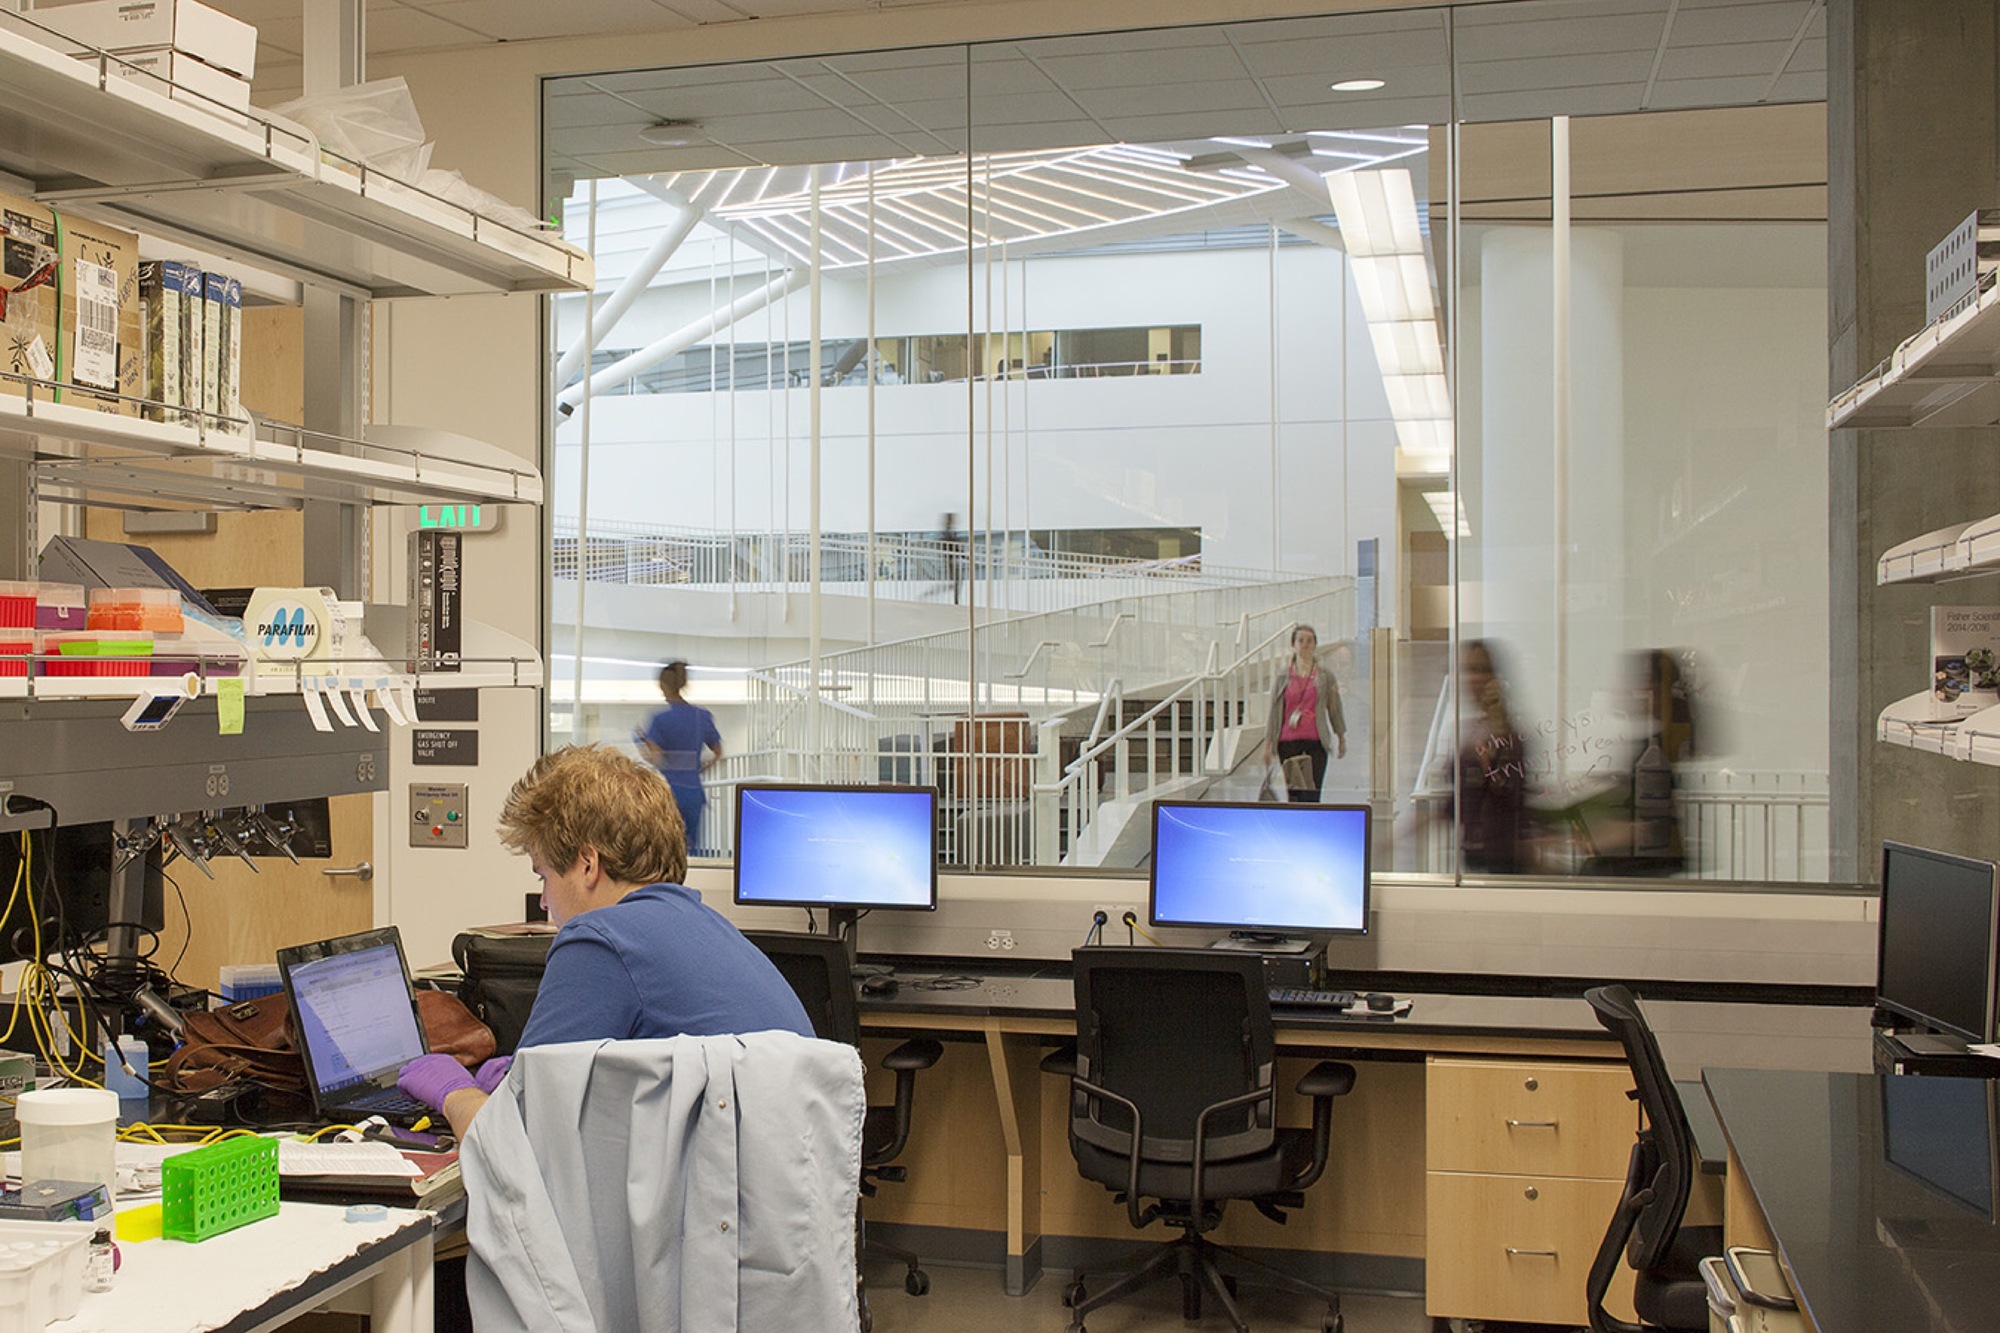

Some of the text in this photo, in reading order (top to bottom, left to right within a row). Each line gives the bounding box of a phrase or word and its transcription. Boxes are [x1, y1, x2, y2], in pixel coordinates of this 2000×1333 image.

[1947, 611, 1971, 621] Fisher
[257, 624, 315, 636] PARAFILM
[1947, 623, 1990, 632] 2014/2016
[417, 732, 451, 740] EMERGENCY
[417, 749, 435, 757] VALVE
